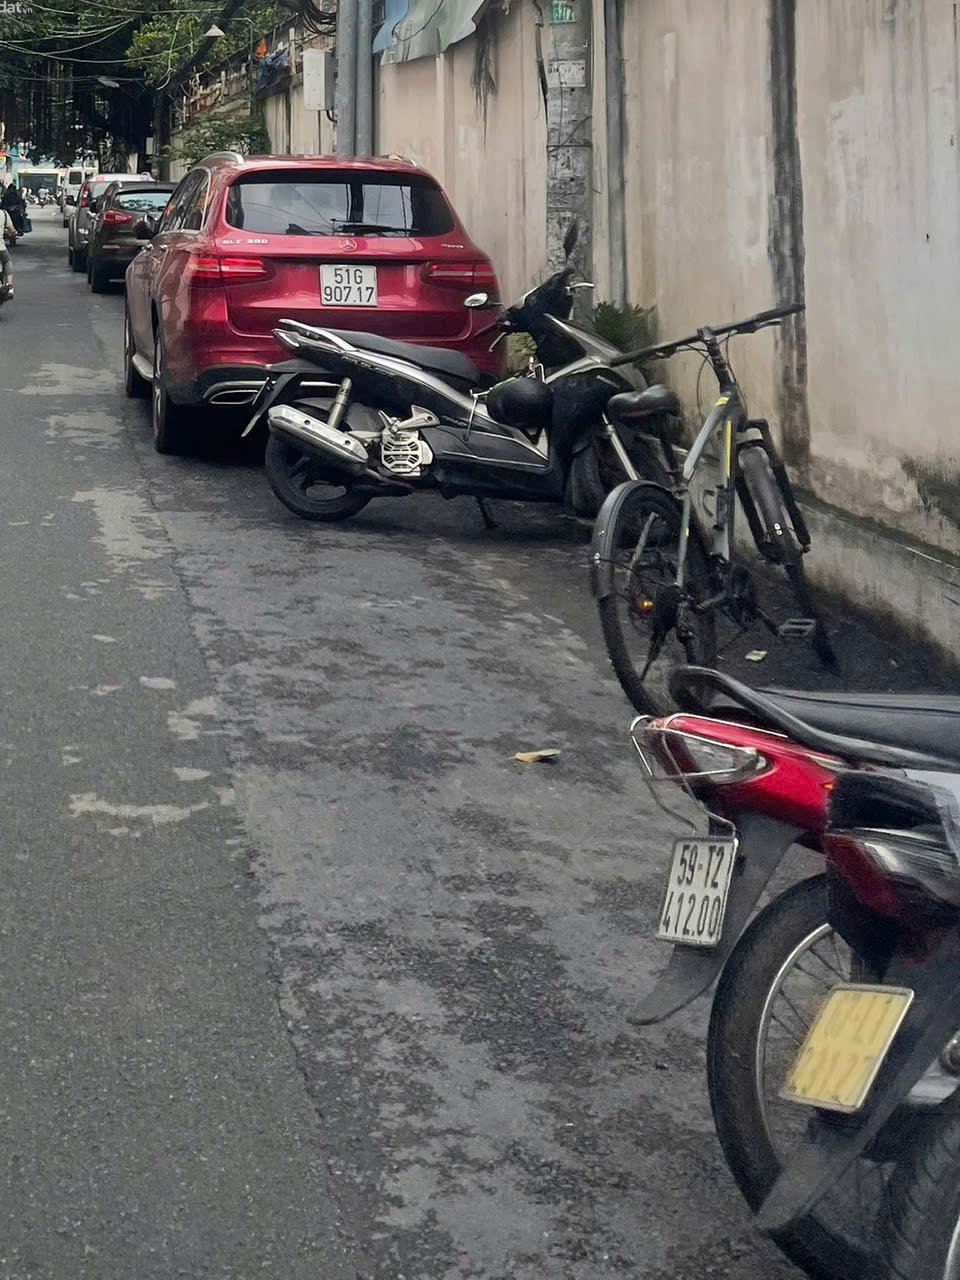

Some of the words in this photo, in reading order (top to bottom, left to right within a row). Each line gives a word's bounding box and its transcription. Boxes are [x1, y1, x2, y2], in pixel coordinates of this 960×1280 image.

[334, 268, 363, 285] 51G
[323, 286, 375, 303] 907.17
[677, 844, 725, 888] 59-T2
[662, 890, 722, 938] 412.00
